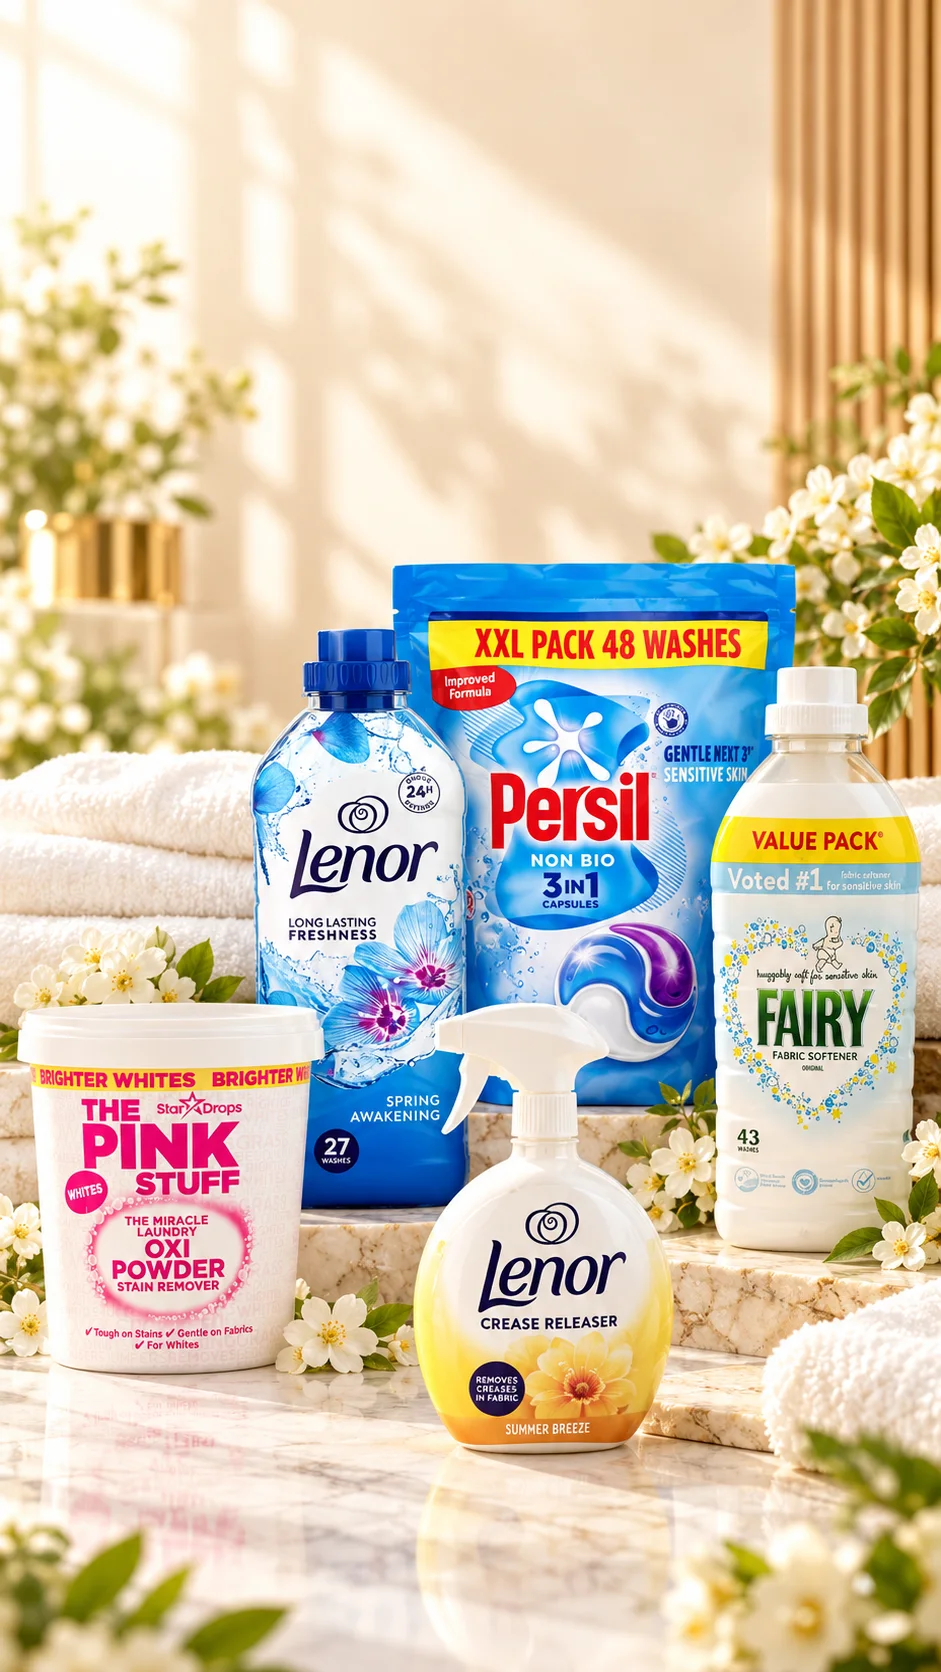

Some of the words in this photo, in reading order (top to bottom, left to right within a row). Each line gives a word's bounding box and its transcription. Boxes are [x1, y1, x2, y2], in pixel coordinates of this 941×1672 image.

[475, 628, 524, 658] XXL
[532, 629, 595, 659] PACK
[602, 629, 634, 659] 48
[644, 628, 741, 658] WASHES
[444, 672, 496, 688] Improved
[449, 687, 492, 699] Formula
[664, 745, 711, 762] GENTLE
[714, 745, 740, 762] NEXT
[664, 766, 724, 782] SENSITIVE
[726, 767, 748, 782] SKIN
[406, 785, 433, 798] 24H
[490, 772, 650, 849] Persil
[752, 831, 816, 850] VALUE
[290, 829, 438, 899] Lenor
[531, 854, 572, 867] NON
[581, 854, 614, 867] BIO
[728, 867, 790, 890] Voted
[796, 867, 822, 890] #1
[826, 880, 840, 890] for
[884, 880, 901, 890] skin
[542, 900, 599, 908] CAPSULES
[288, 918, 323, 928] LONG
[326, 917, 376, 928] LASTING
[288, 930, 377, 940] FRESHNESS
[756, 988, 875, 1047] FAIRY
[772, 1050, 805, 1060] FABRIC
[808, 1052, 858, 1060] SOFTENER
[40, 1069, 108, 1088] BRIGHTER
[112, 1072, 196, 1088] WHITES
[212, 1068, 294, 1087] BRIGHTER
[386, 1094, 440, 1107] SPRING
[81, 1098, 140, 1122] THE
[350, 1110, 440, 1122] AWAKENING
[737, 1128, 760, 1146] 43
[82, 1121, 240, 1170] PINK
[324, 1137, 350, 1156] 27
[136, 1170, 240, 1195] STUFF
[68, 1183, 103, 1200] WHITES
[125, 1216, 148, 1226] THE
[153, 1215, 208, 1226] MIRACLE
[138, 1226, 197, 1237] LAUNDRY
[144, 1238, 190, 1258] OXI
[112, 1258, 224, 1280] POWDER
[478, 1239, 627, 1313] Lenor
[117, 1282, 153, 1292] STAIN
[158, 1280, 220, 1292] REMOVER
[480, 1317, 540, 1330] CREASE
[545, 1315, 618, 1330] RELEASER
[94, 1328, 120, 1340] Tough
[122, 1330, 132, 1338] on
[135, 1328, 163, 1338] Stains
[177, 1328, 208, 1338] Gentle
[224, 1324, 253, 1336] Fabrics
[147, 1341, 163, 1350] For
[166, 1340, 199, 1350] Whites
[476, 1376, 518, 1384] REMOVES
[476, 1385, 517, 1394] CREASES
[475, 1394, 485, 1402] IN
[487, 1394, 519, 1402] FABRIC
[506, 1423, 550, 1435] SUMMER
[552, 1422, 590, 1434] BREEZE
